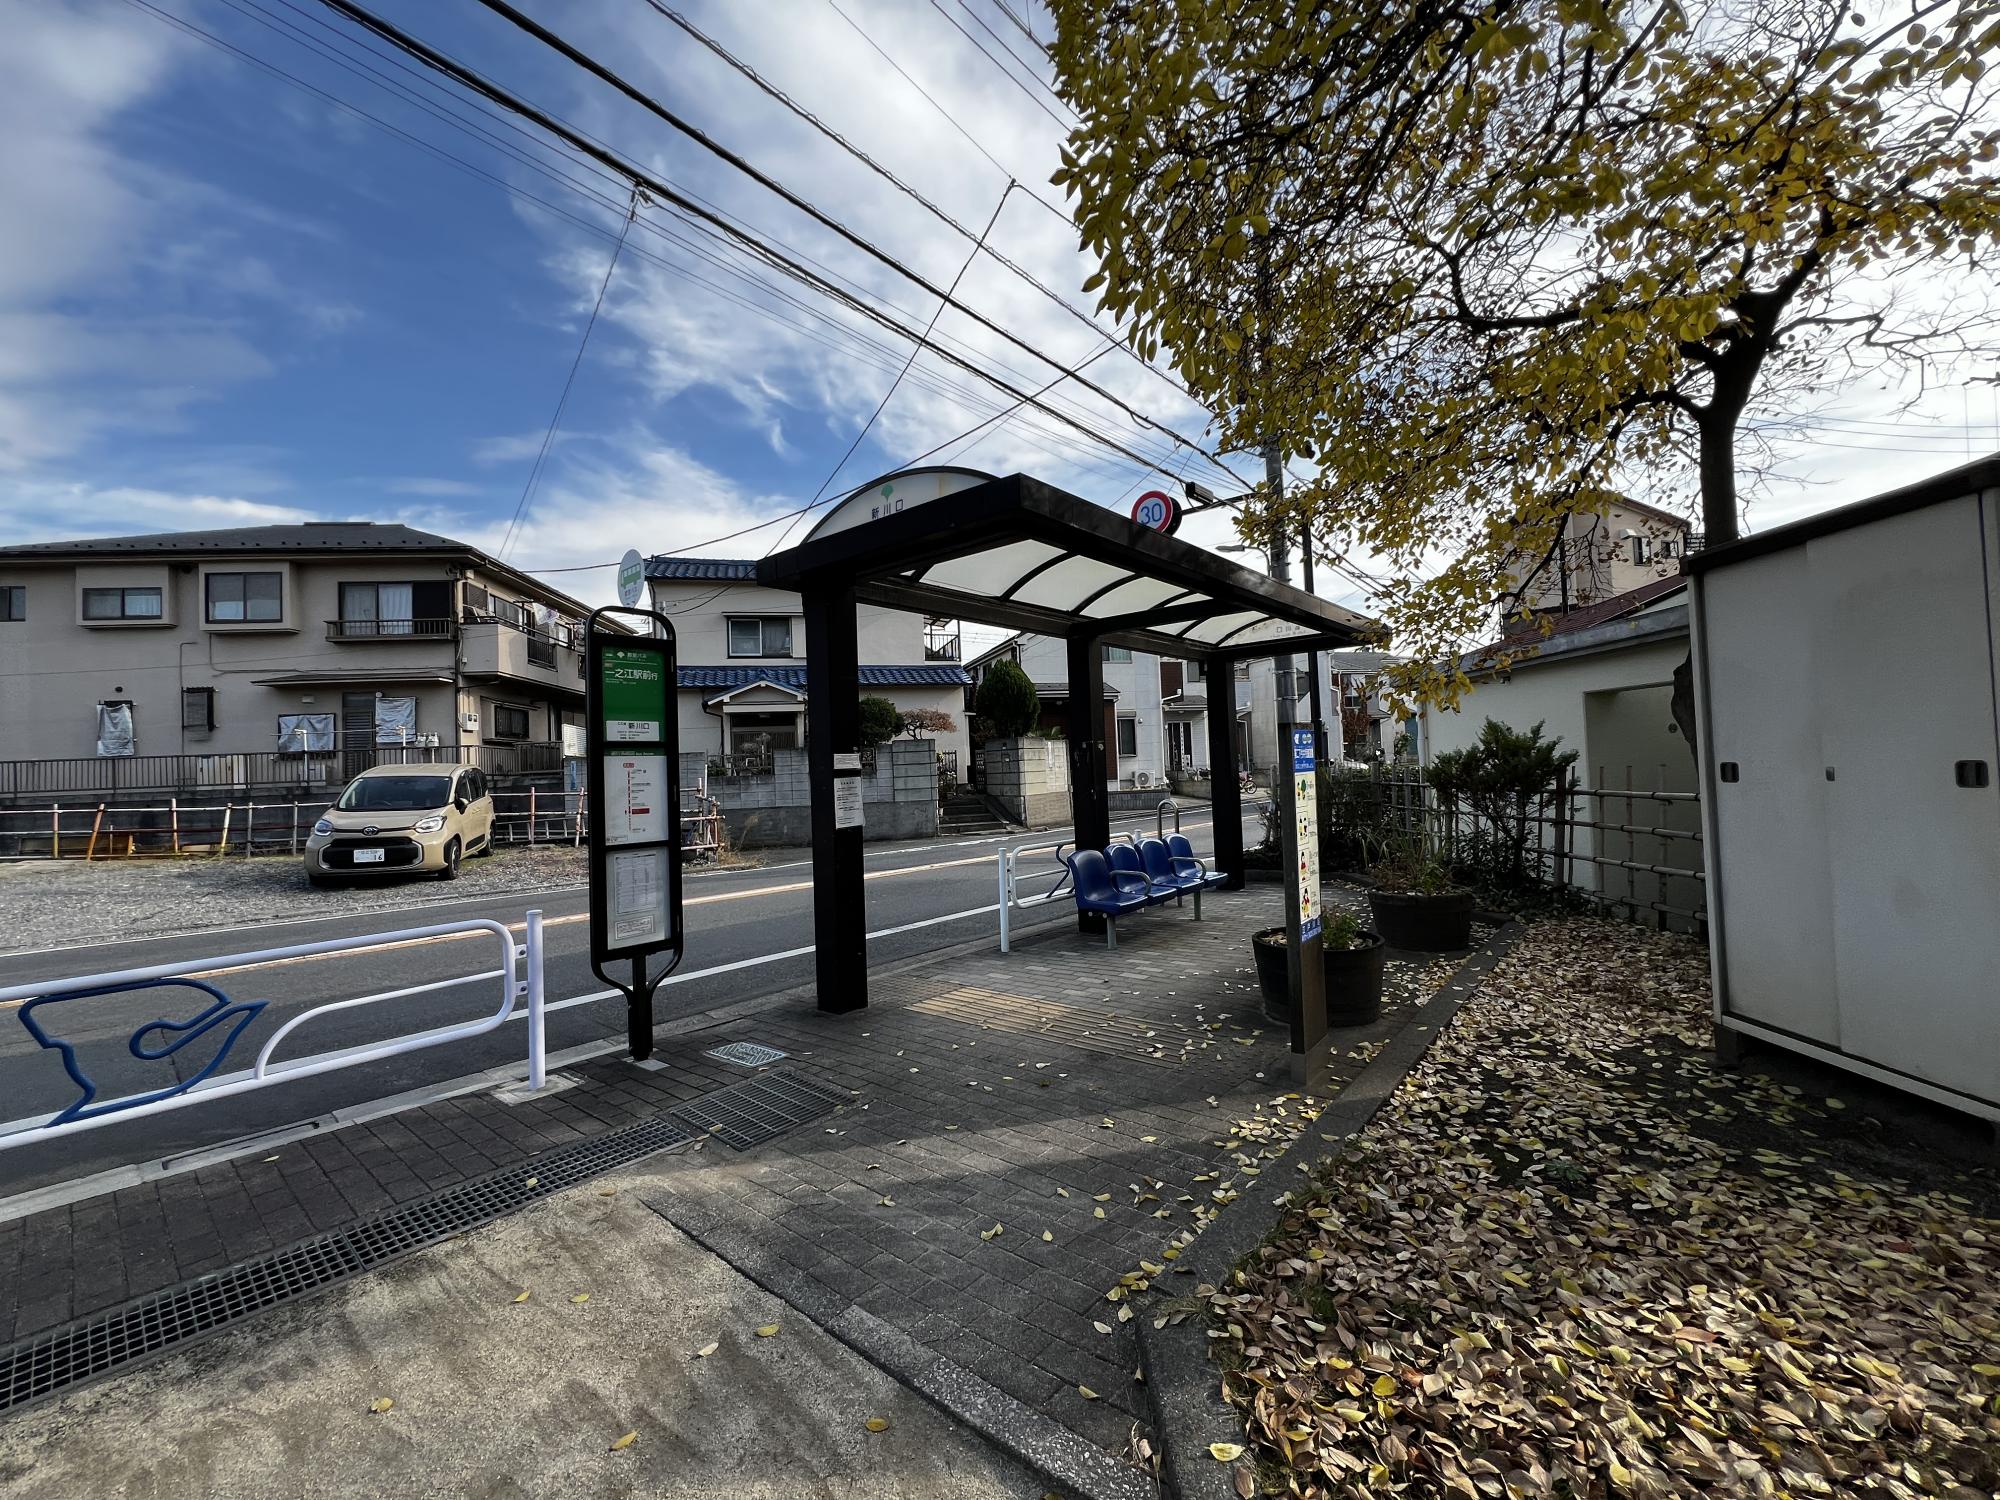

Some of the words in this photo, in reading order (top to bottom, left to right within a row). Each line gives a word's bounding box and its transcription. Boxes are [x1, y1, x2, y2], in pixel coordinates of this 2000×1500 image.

[871, 499, 904, 520] 新川口
[1140, 502, 1162, 525] 30
